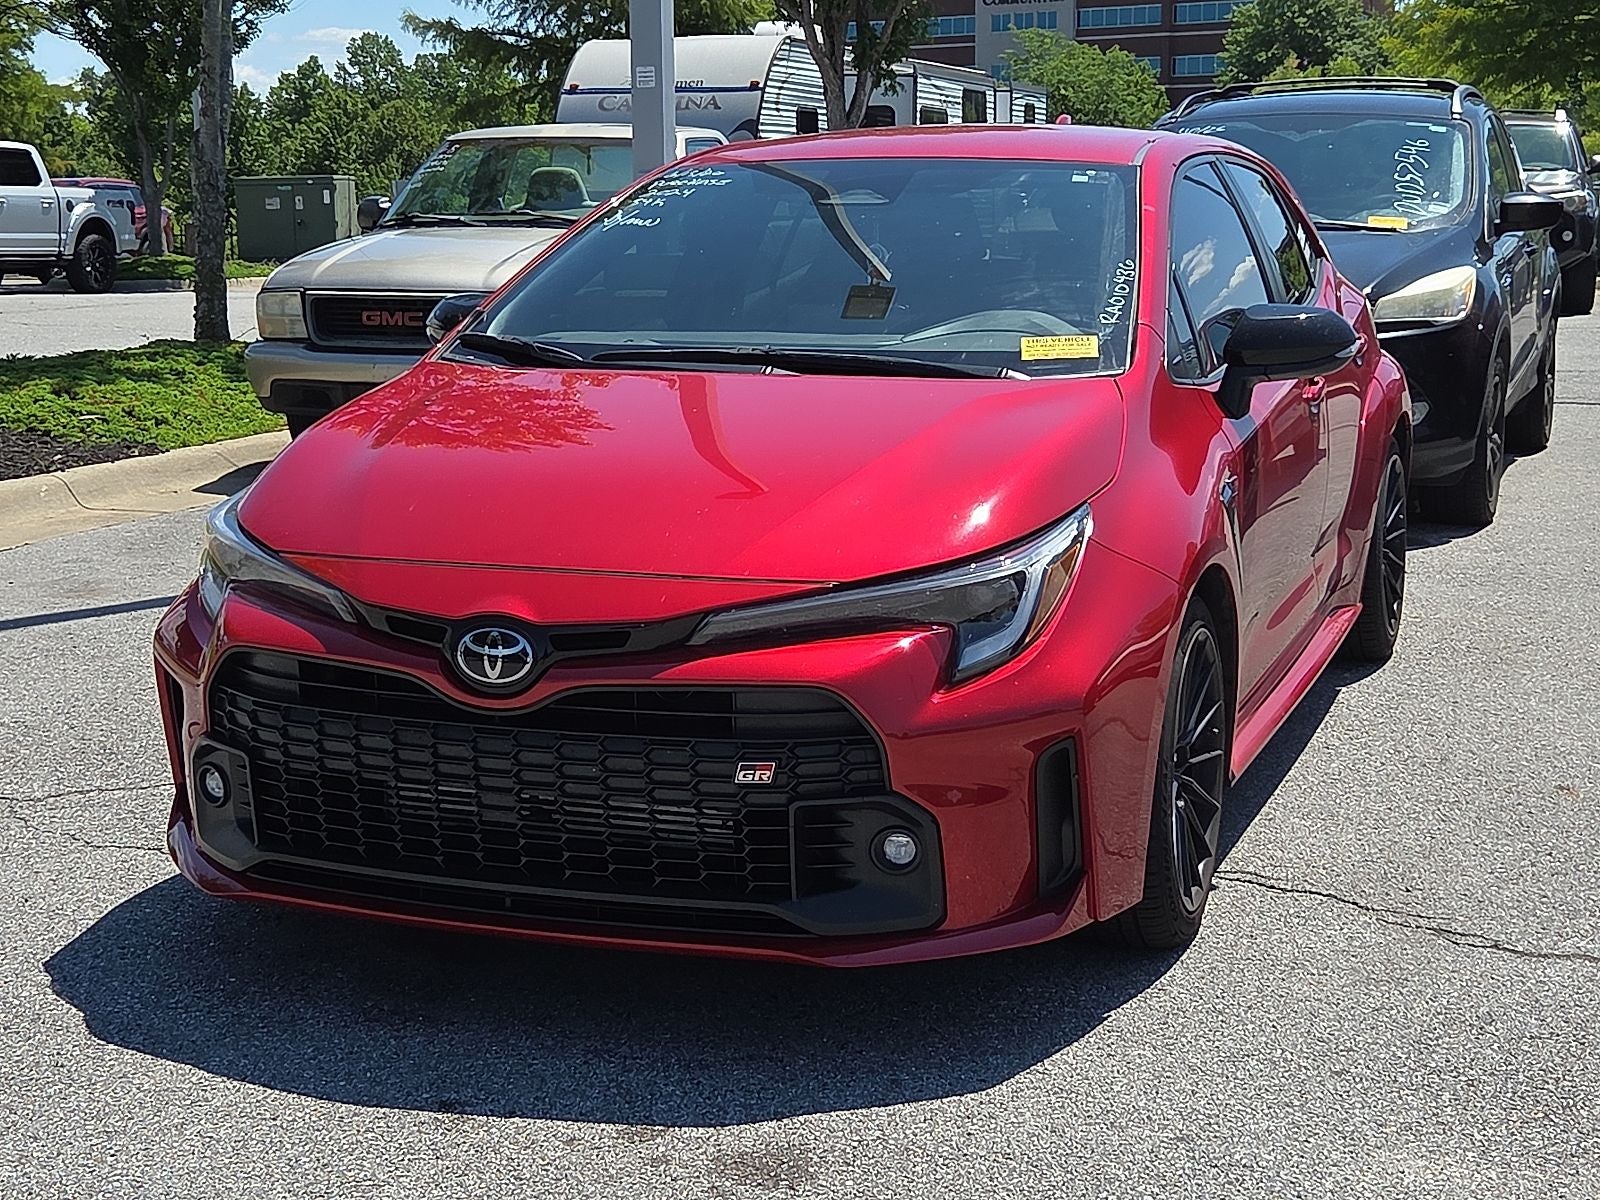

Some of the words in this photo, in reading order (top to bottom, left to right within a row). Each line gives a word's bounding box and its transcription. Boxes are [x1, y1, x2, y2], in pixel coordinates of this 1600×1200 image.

[598, 96, 722, 112] CAINA
[361, 311, 423, 326] GMC
[738, 771, 771, 780] GR
